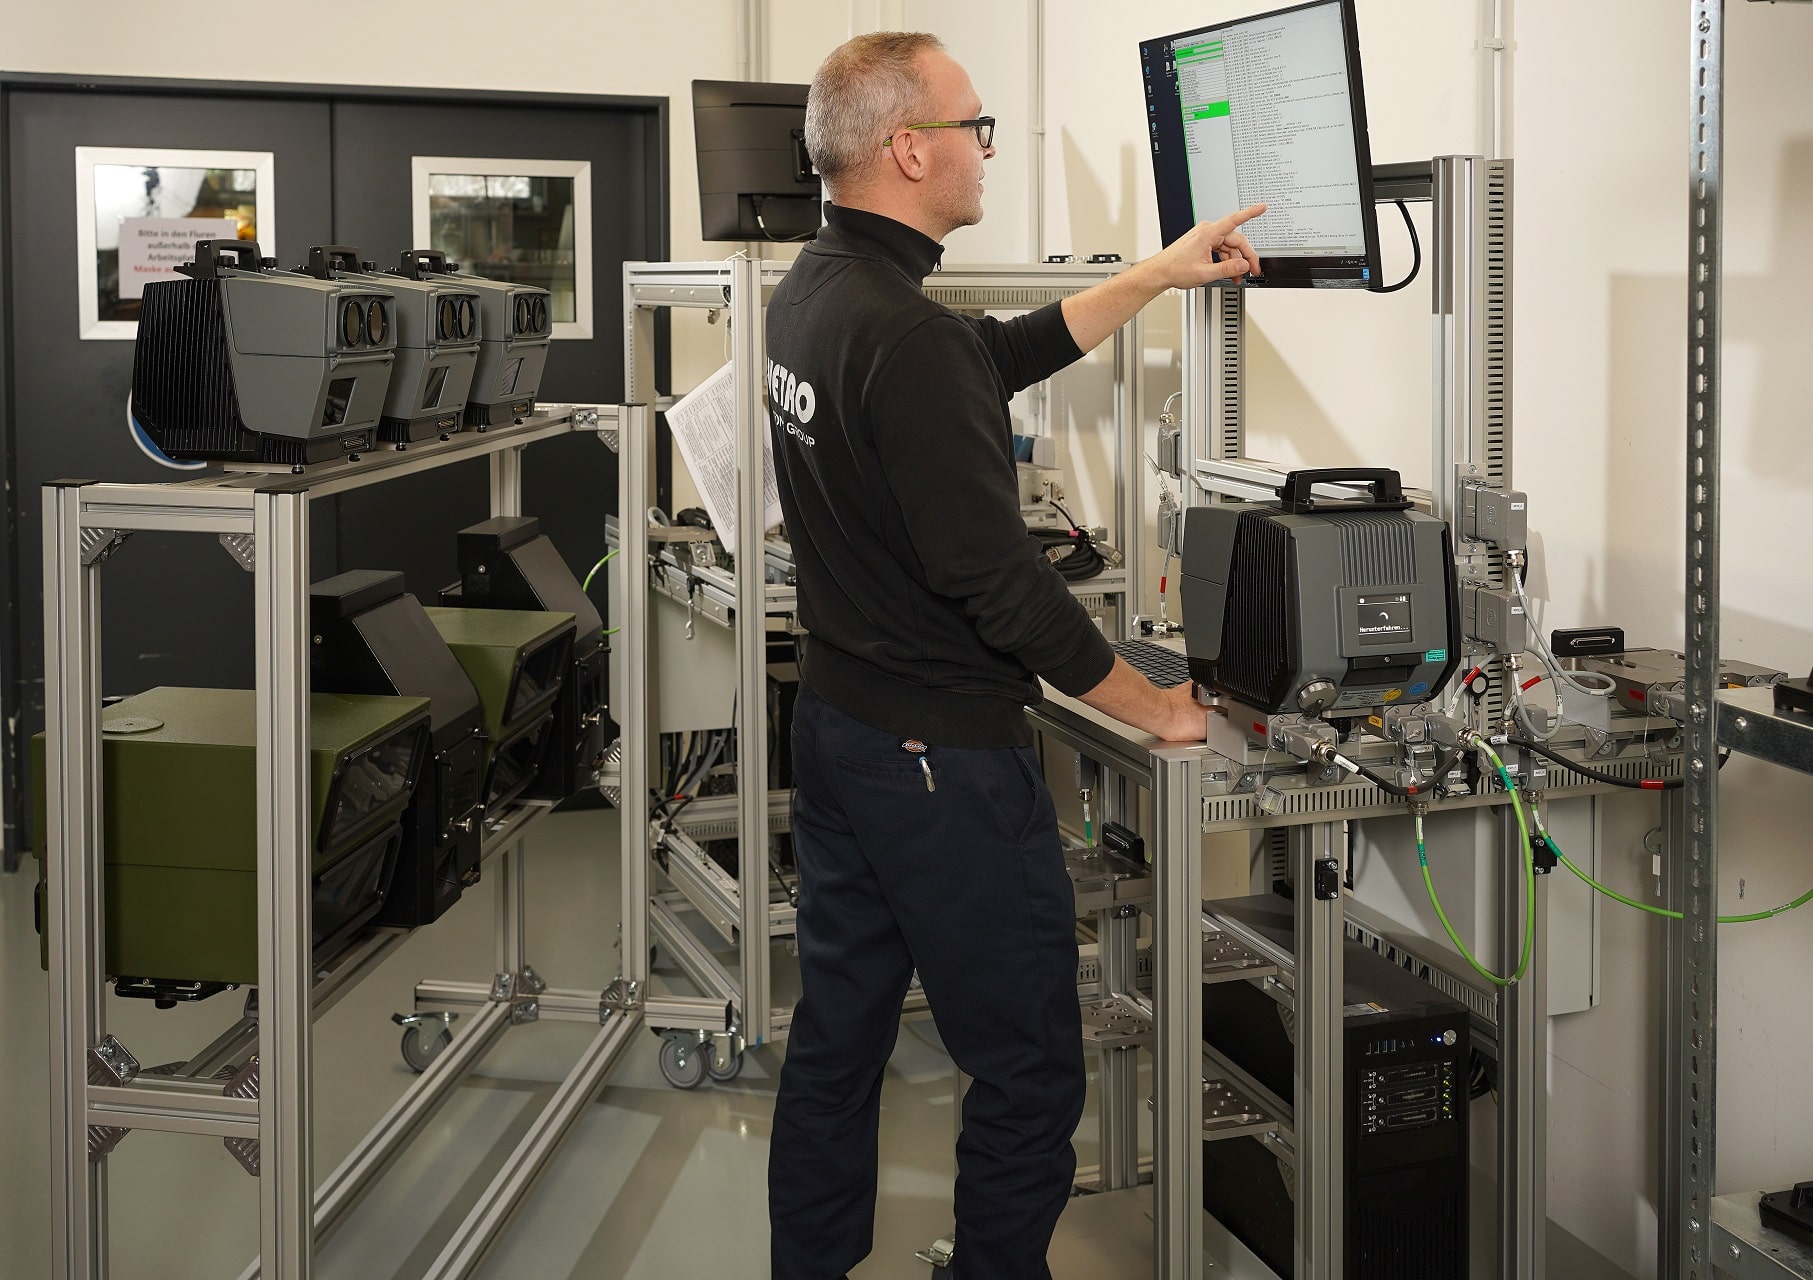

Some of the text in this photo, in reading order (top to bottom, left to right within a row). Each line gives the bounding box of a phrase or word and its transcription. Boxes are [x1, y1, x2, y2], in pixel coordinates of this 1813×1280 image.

[138, 230, 217, 239] Bitte in den Fluren
[133, 265, 161, 273] Maske
[786, 422, 816, 448] GROUP
